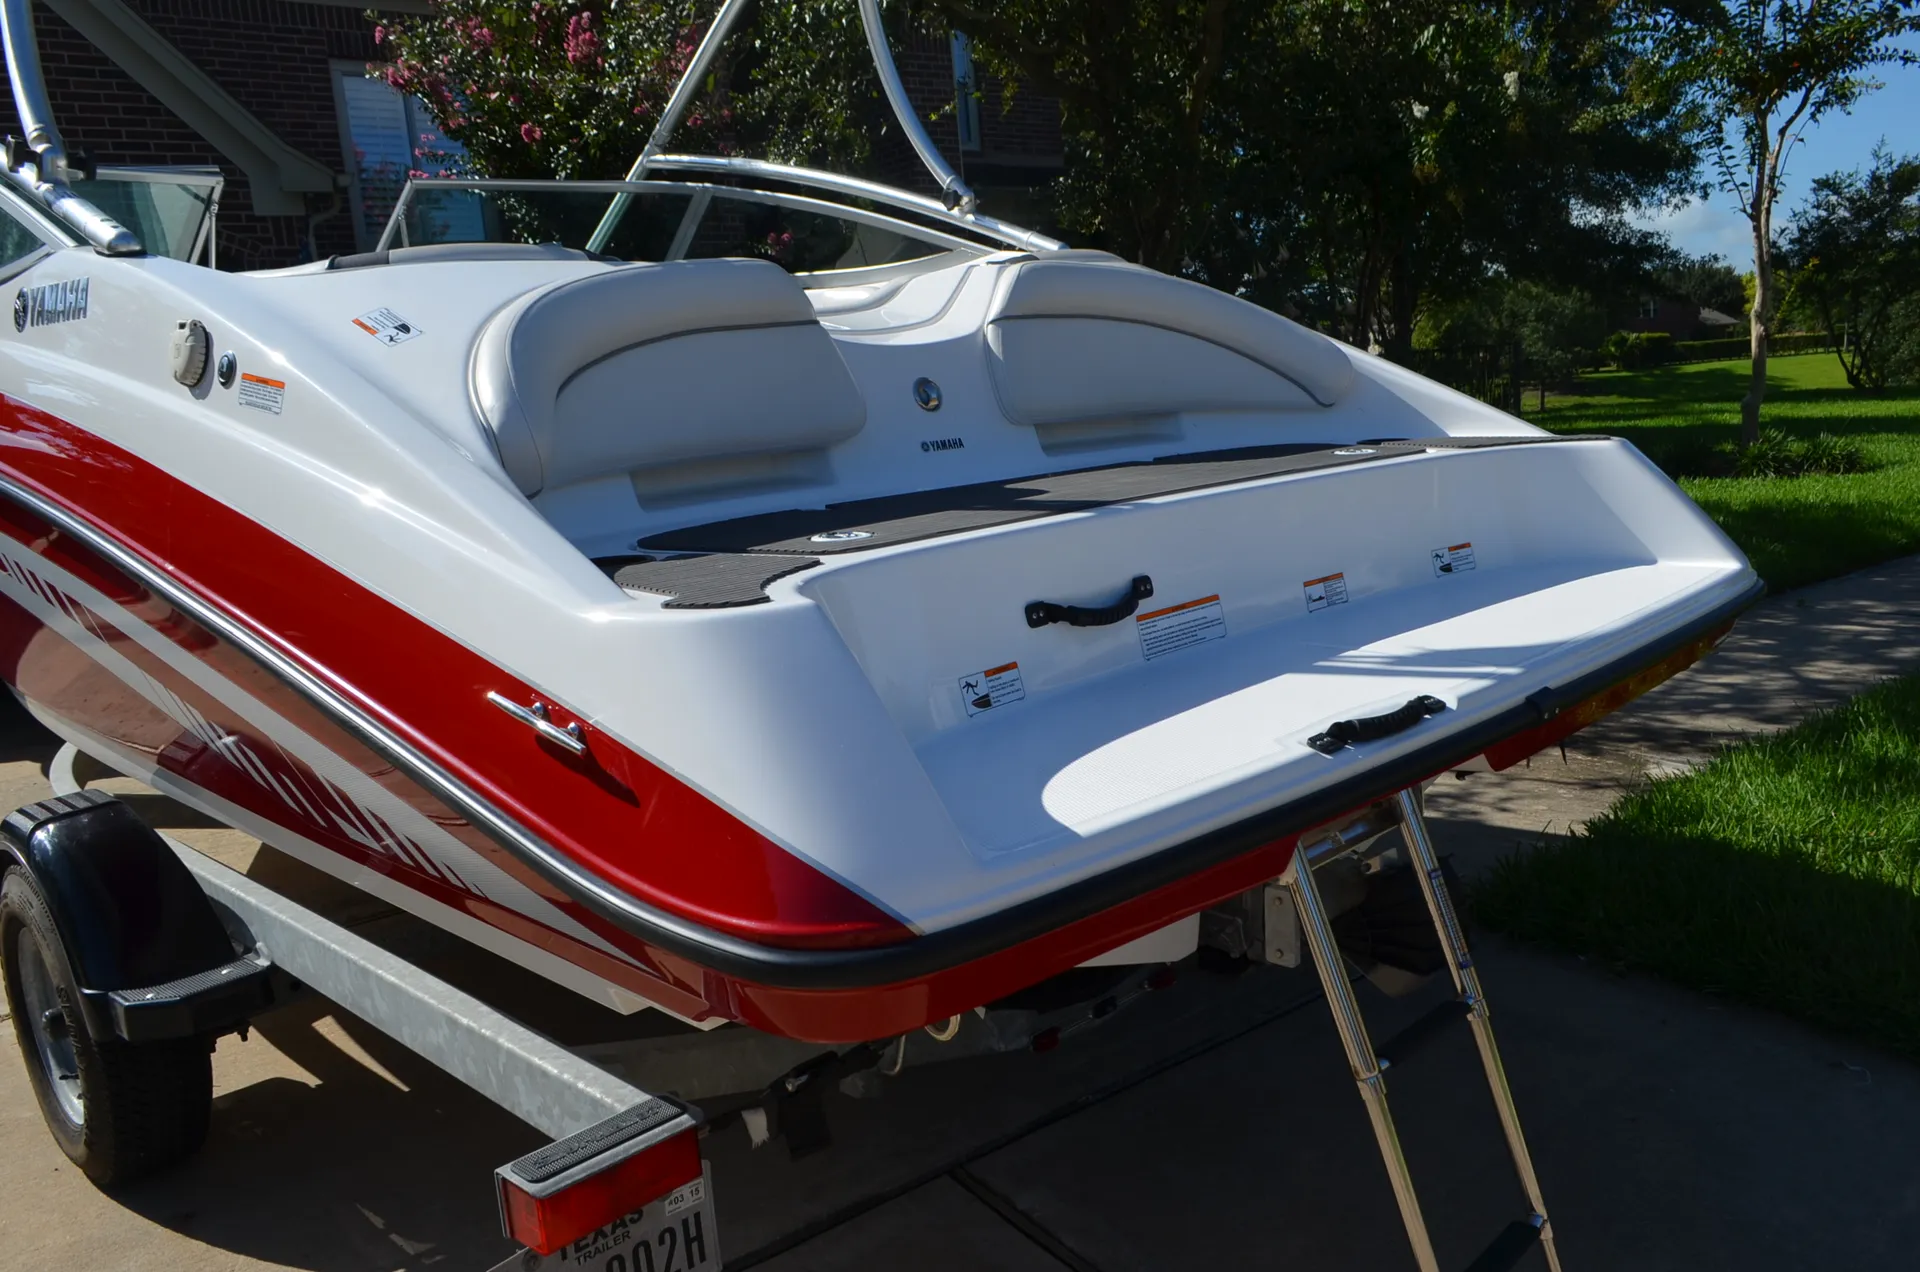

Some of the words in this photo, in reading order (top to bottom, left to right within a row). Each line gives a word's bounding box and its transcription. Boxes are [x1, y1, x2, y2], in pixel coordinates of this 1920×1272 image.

[30, 276, 90, 327] YAMAHA
[929, 437, 965, 452] YAMAHA
[689, 1186, 700, 1197] 15
[574, 1230, 631, 1266] TRAILER
